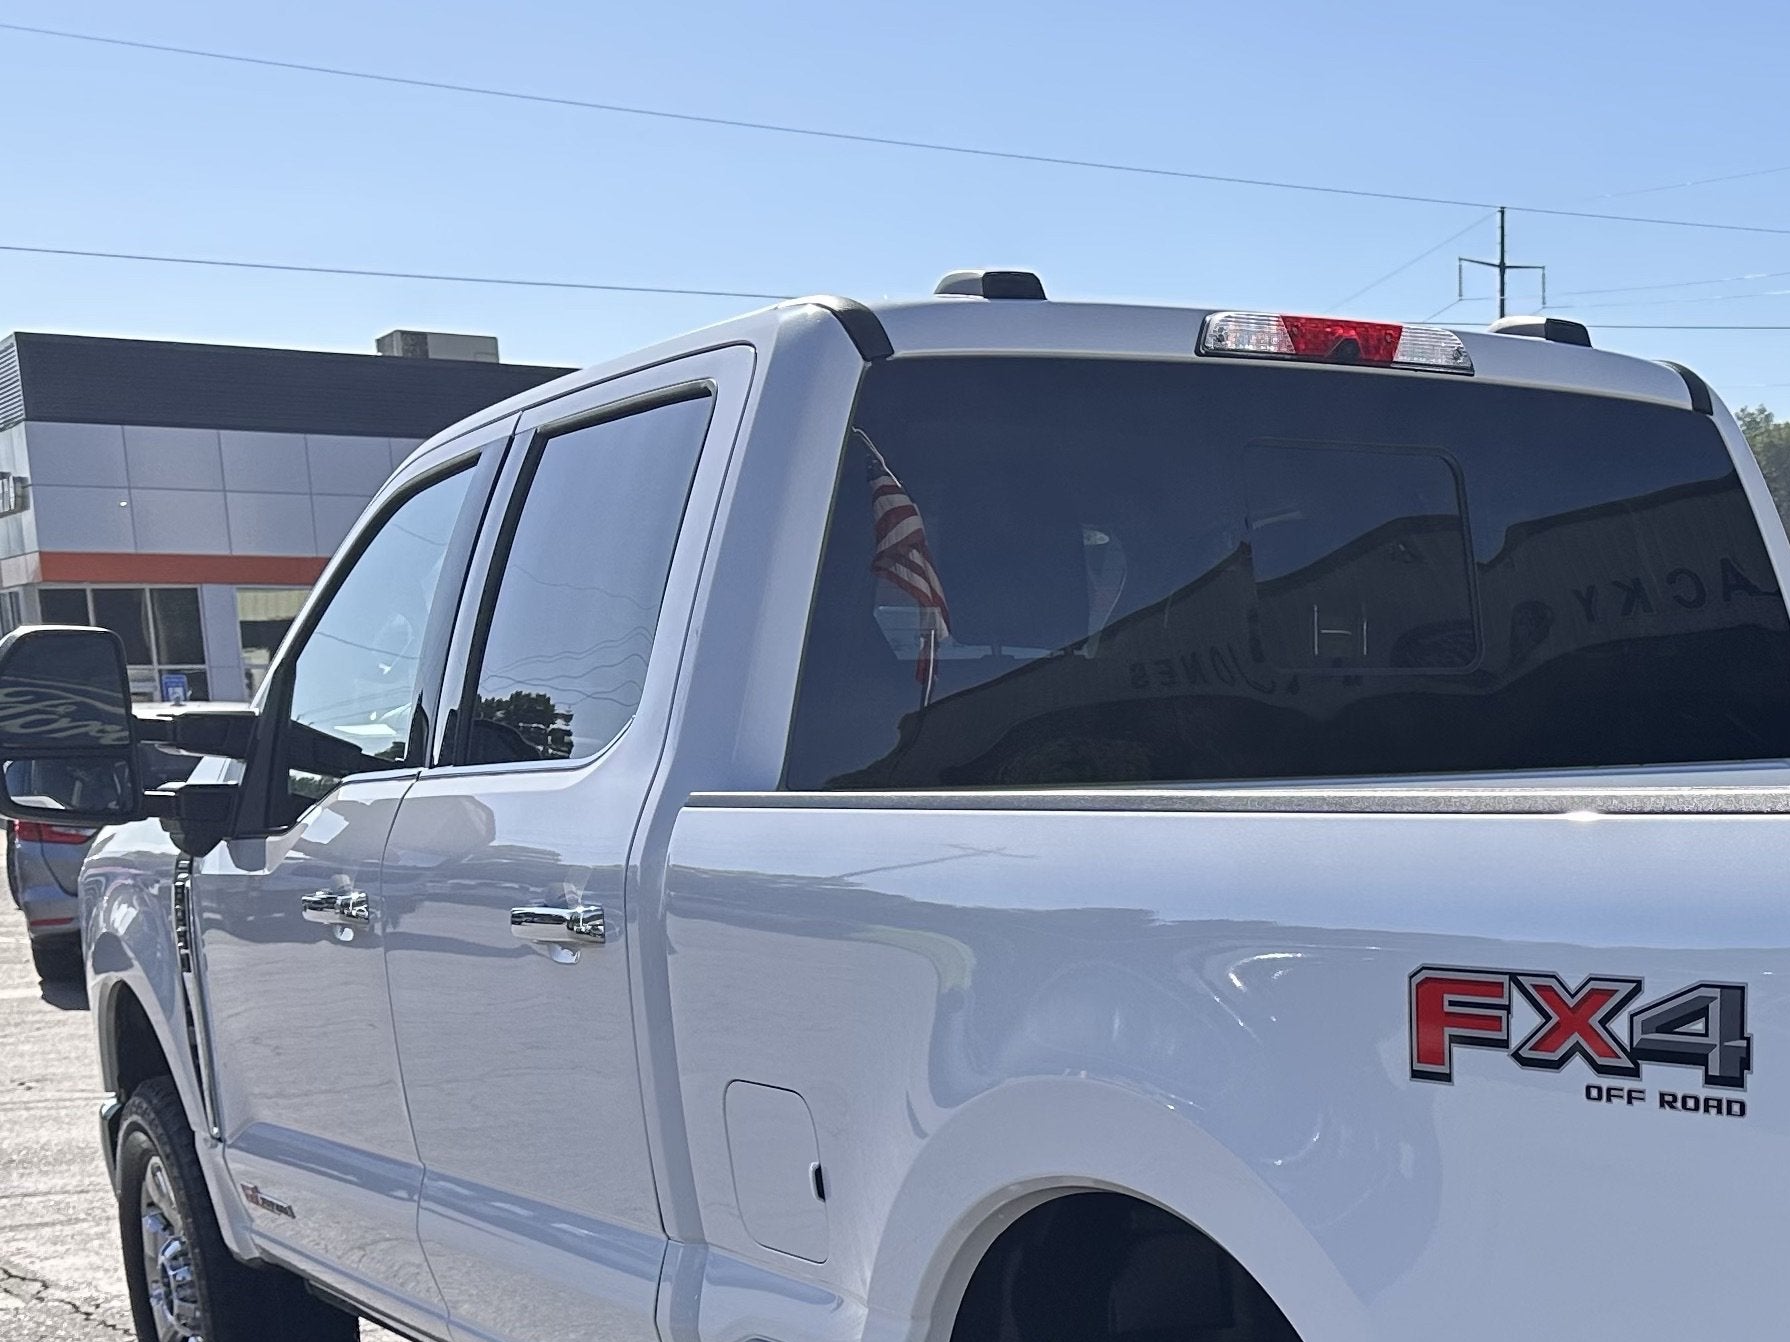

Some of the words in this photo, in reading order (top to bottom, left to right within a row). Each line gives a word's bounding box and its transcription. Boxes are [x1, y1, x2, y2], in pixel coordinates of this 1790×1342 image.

[1408, 963, 1753, 1092] FX4
[1584, 1083, 1647, 1106] OFF
[1658, 1089, 1747, 1119] ROAD
